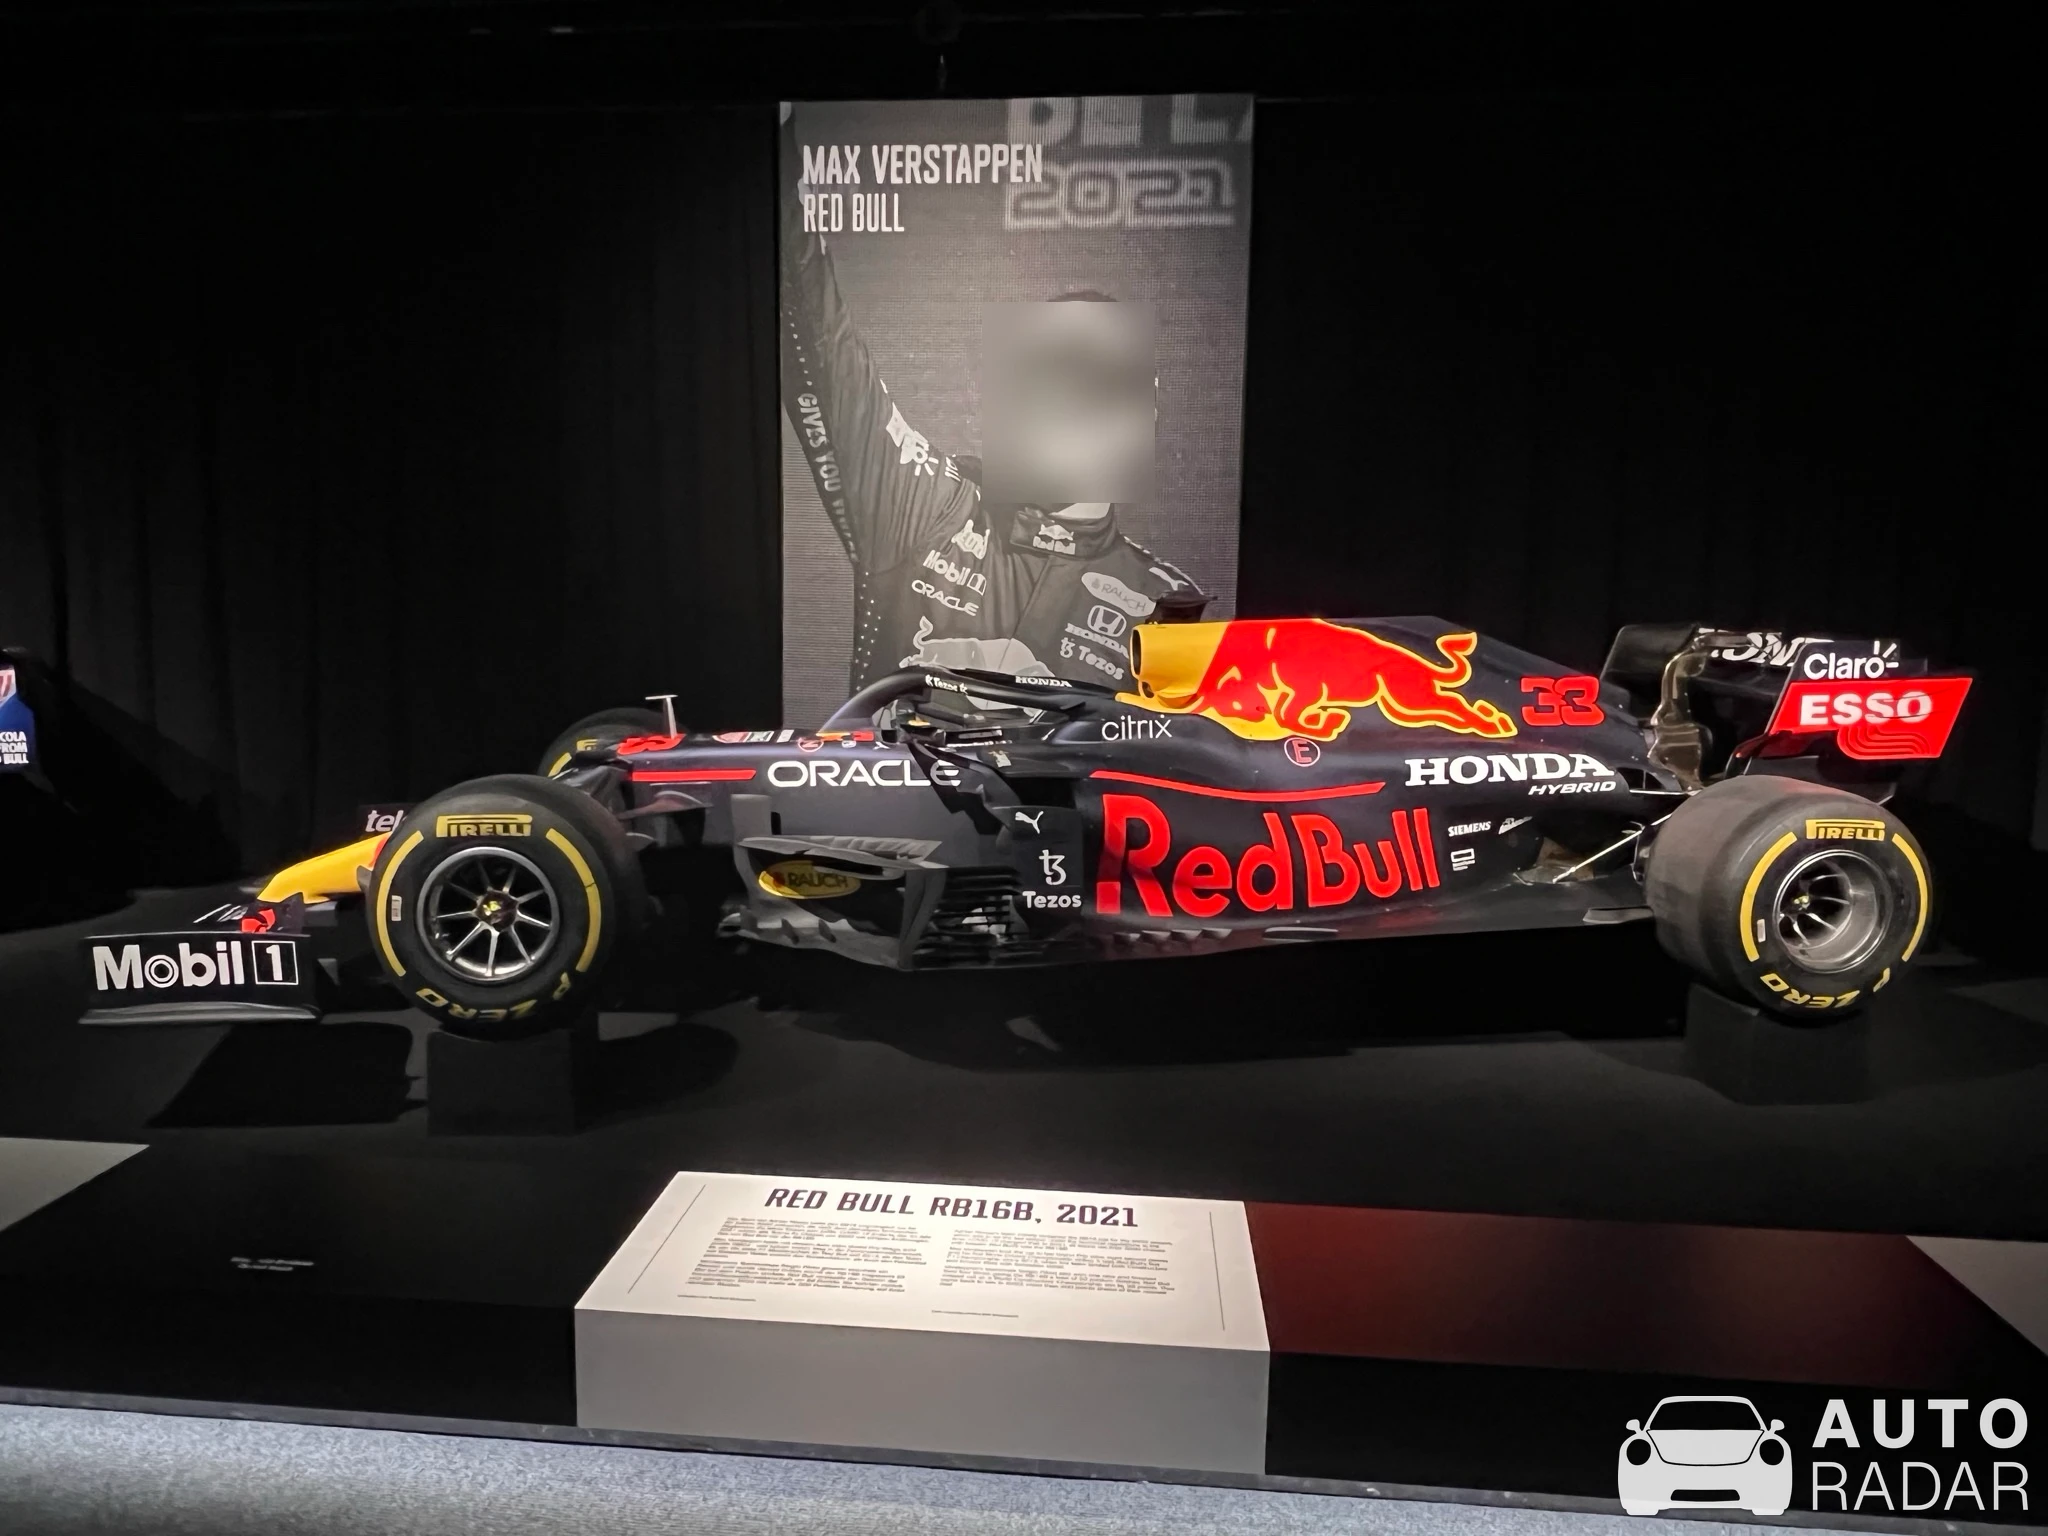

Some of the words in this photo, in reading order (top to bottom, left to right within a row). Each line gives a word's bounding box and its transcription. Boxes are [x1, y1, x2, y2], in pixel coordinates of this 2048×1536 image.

[803, 145, 860, 185] MAX
[872, 143, 1042, 185] VERSTAPPEN
[1003, 159, 1236, 231] 2021
[804, 193, 843, 233] RED
[852, 192, 905, 232] BULL
[797, 393, 829, 449] GIVES
[814, 450, 842, 492] YOU
[923, 549, 971, 586] Mobil
[911, 579, 980, 617] ORACLE
[1102, 582, 1147, 613] RAUCH
[1064, 623, 1130, 659] HONDA
[1078, 645, 1124, 680] Tezos
[1803, 652, 1886, 680] Claro
[1015, 675, 1073, 688] HONDA
[1520, 676, 1605, 727] 33
[1800, 691, 1932, 726] ESSO
[1101, 714, 1172, 742] citrix
[1292, 741, 1311, 765] E
[767, 759, 962, 788] ORACLE
[1405, 753, 1616, 788] HONDA
[1528, 780, 1617, 796] HYBRID
[365, 809, 408, 832] tel
[436, 814, 533, 838] PIRELLI
[1448, 821, 1492, 837] SIEMENS
[1805, 818, 1886, 842] PIRELLI
[788, 871, 849, 890] RAUCH
[1022, 890, 1082, 909] Tezos
[92, 940, 245, 990] Mobil
[416, 987, 538, 1019] ZERO
[1759, 972, 1860, 1009] ZERO
[764, 1188, 828, 1210] RED
[836, 1192, 915, 1215] BULL
[1056, 1203, 1139, 1228] 2021
